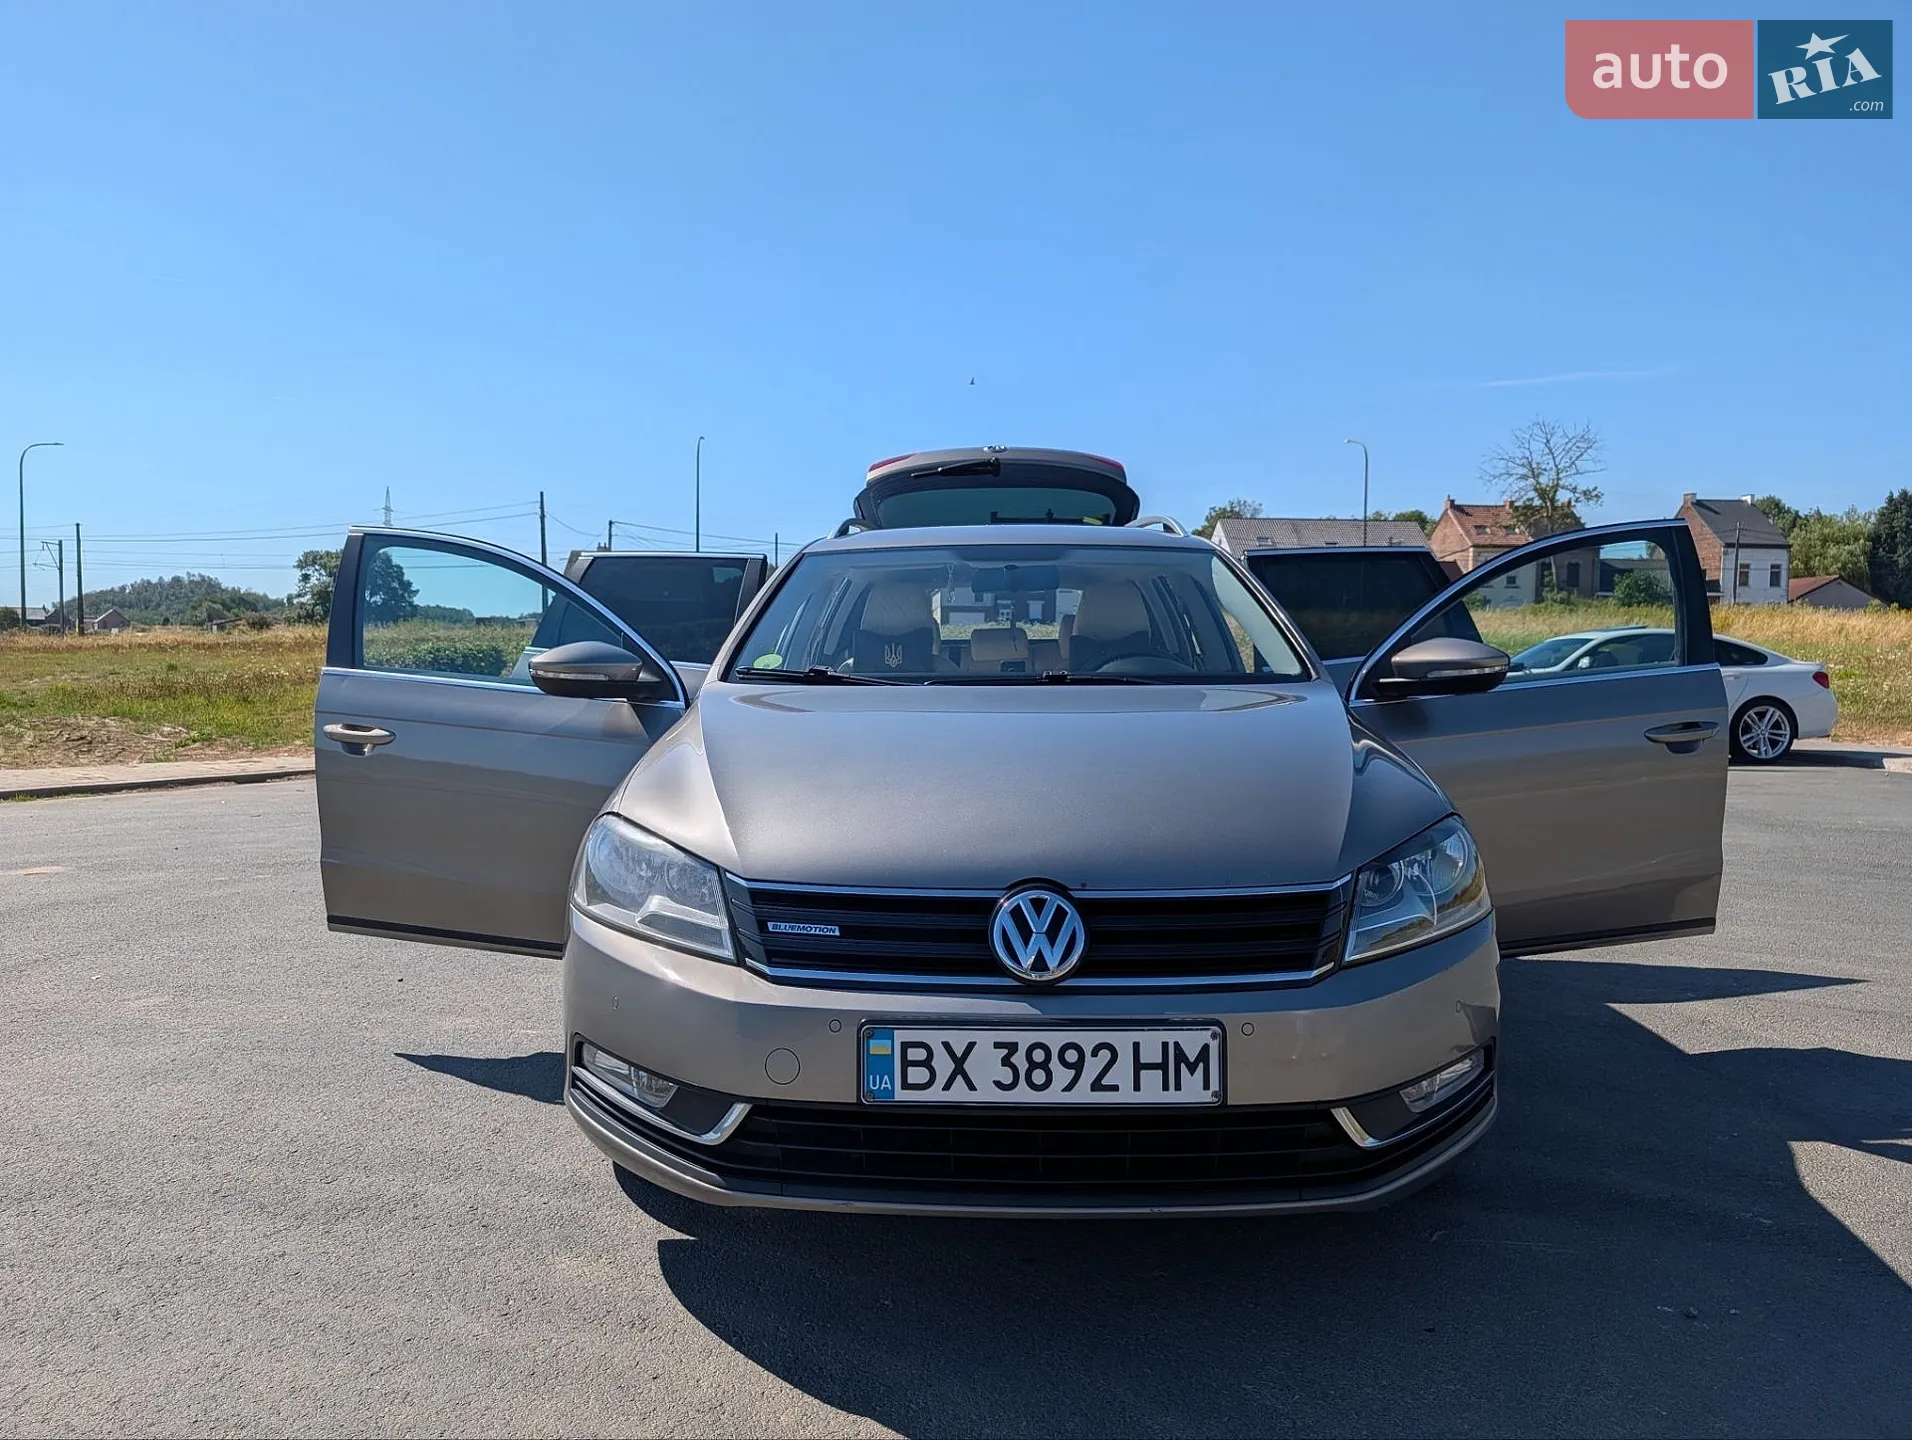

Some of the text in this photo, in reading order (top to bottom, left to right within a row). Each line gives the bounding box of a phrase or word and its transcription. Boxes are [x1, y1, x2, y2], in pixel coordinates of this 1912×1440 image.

[771, 923, 838, 934] BLUEMOTION
[899, 1041, 1211, 1093] BX 3892 HM
[869, 1074, 892, 1091] UA
